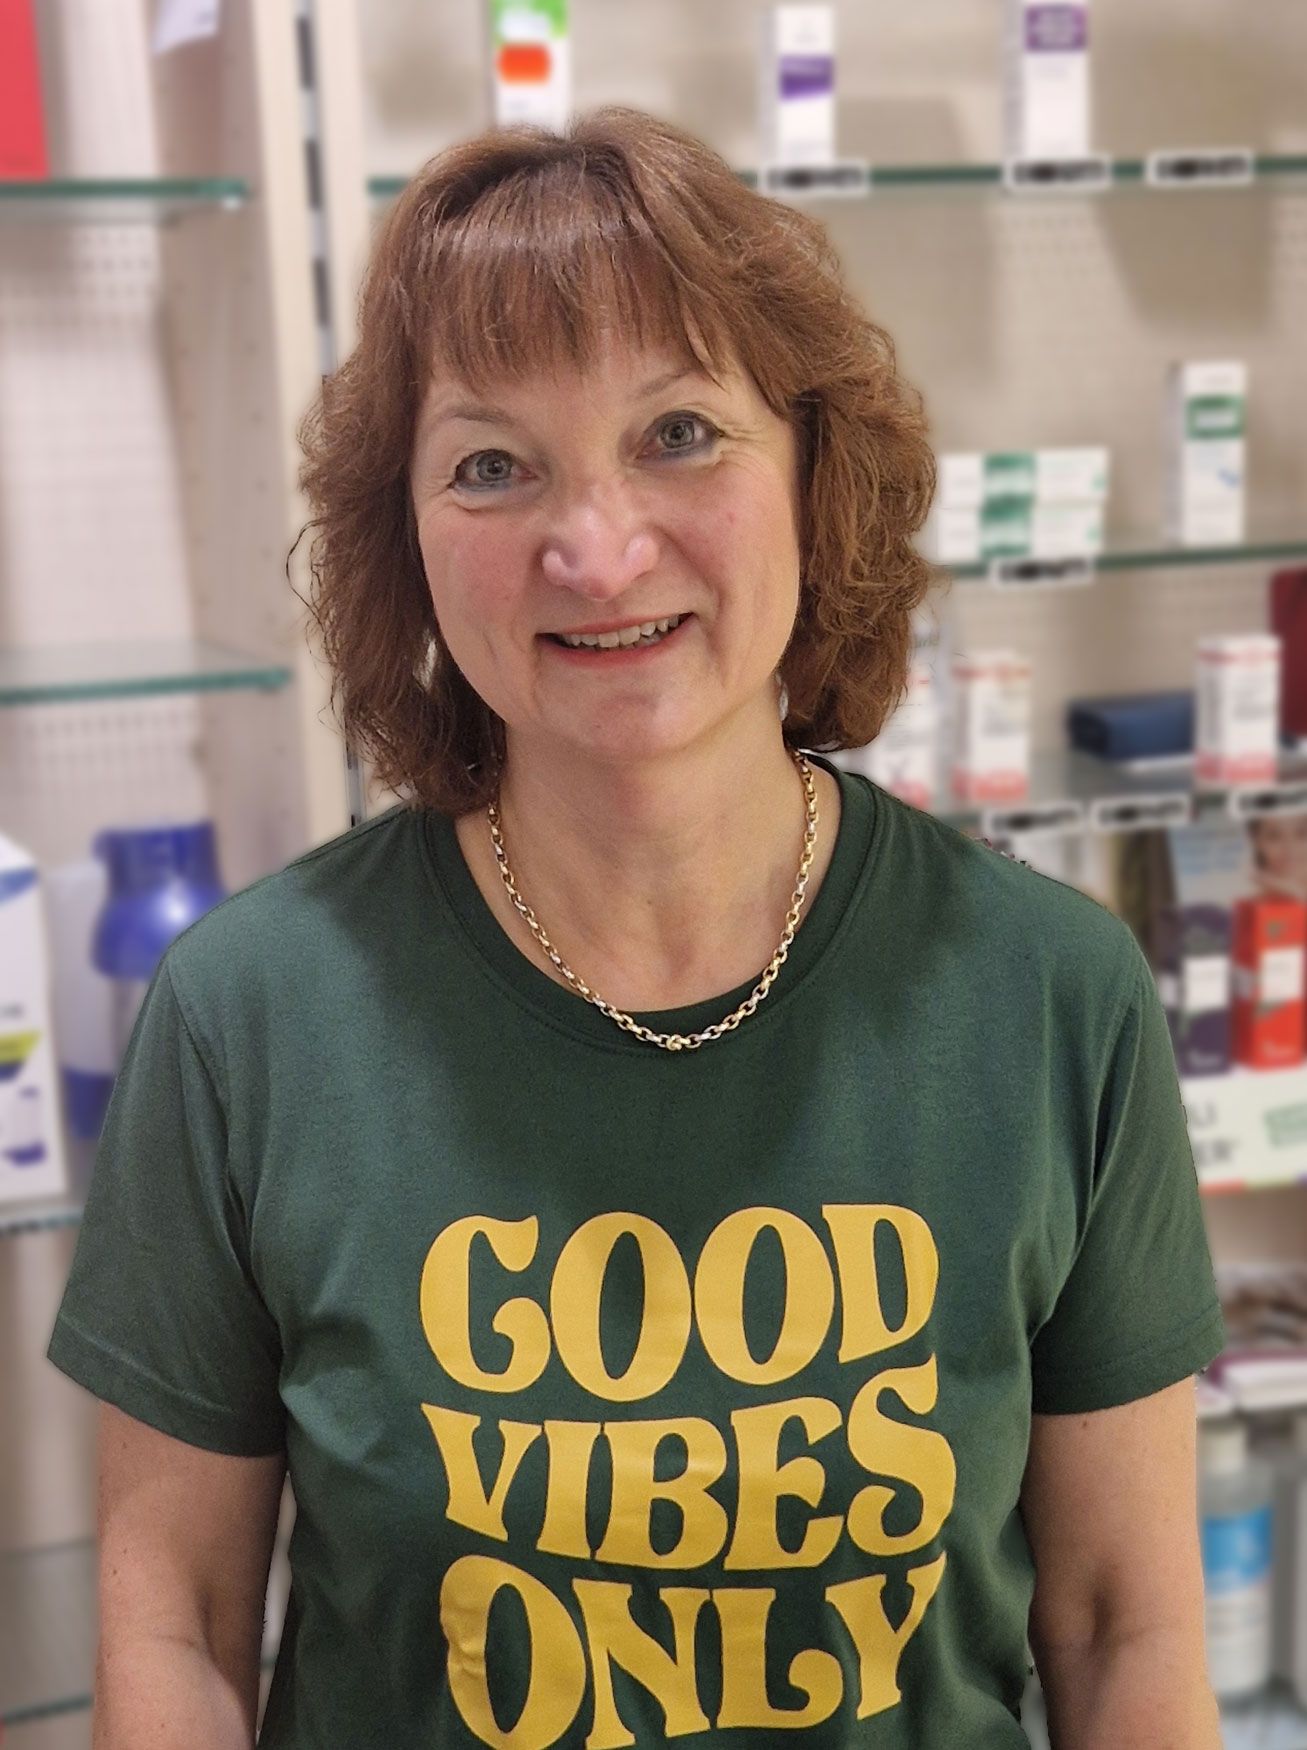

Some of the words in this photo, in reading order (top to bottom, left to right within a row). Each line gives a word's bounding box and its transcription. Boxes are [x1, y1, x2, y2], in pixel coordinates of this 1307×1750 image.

[419, 1204, 939, 1402] GOOD
[421, 1352, 957, 1570] VIBES
[440, 1552, 946, 1750] ONLY
